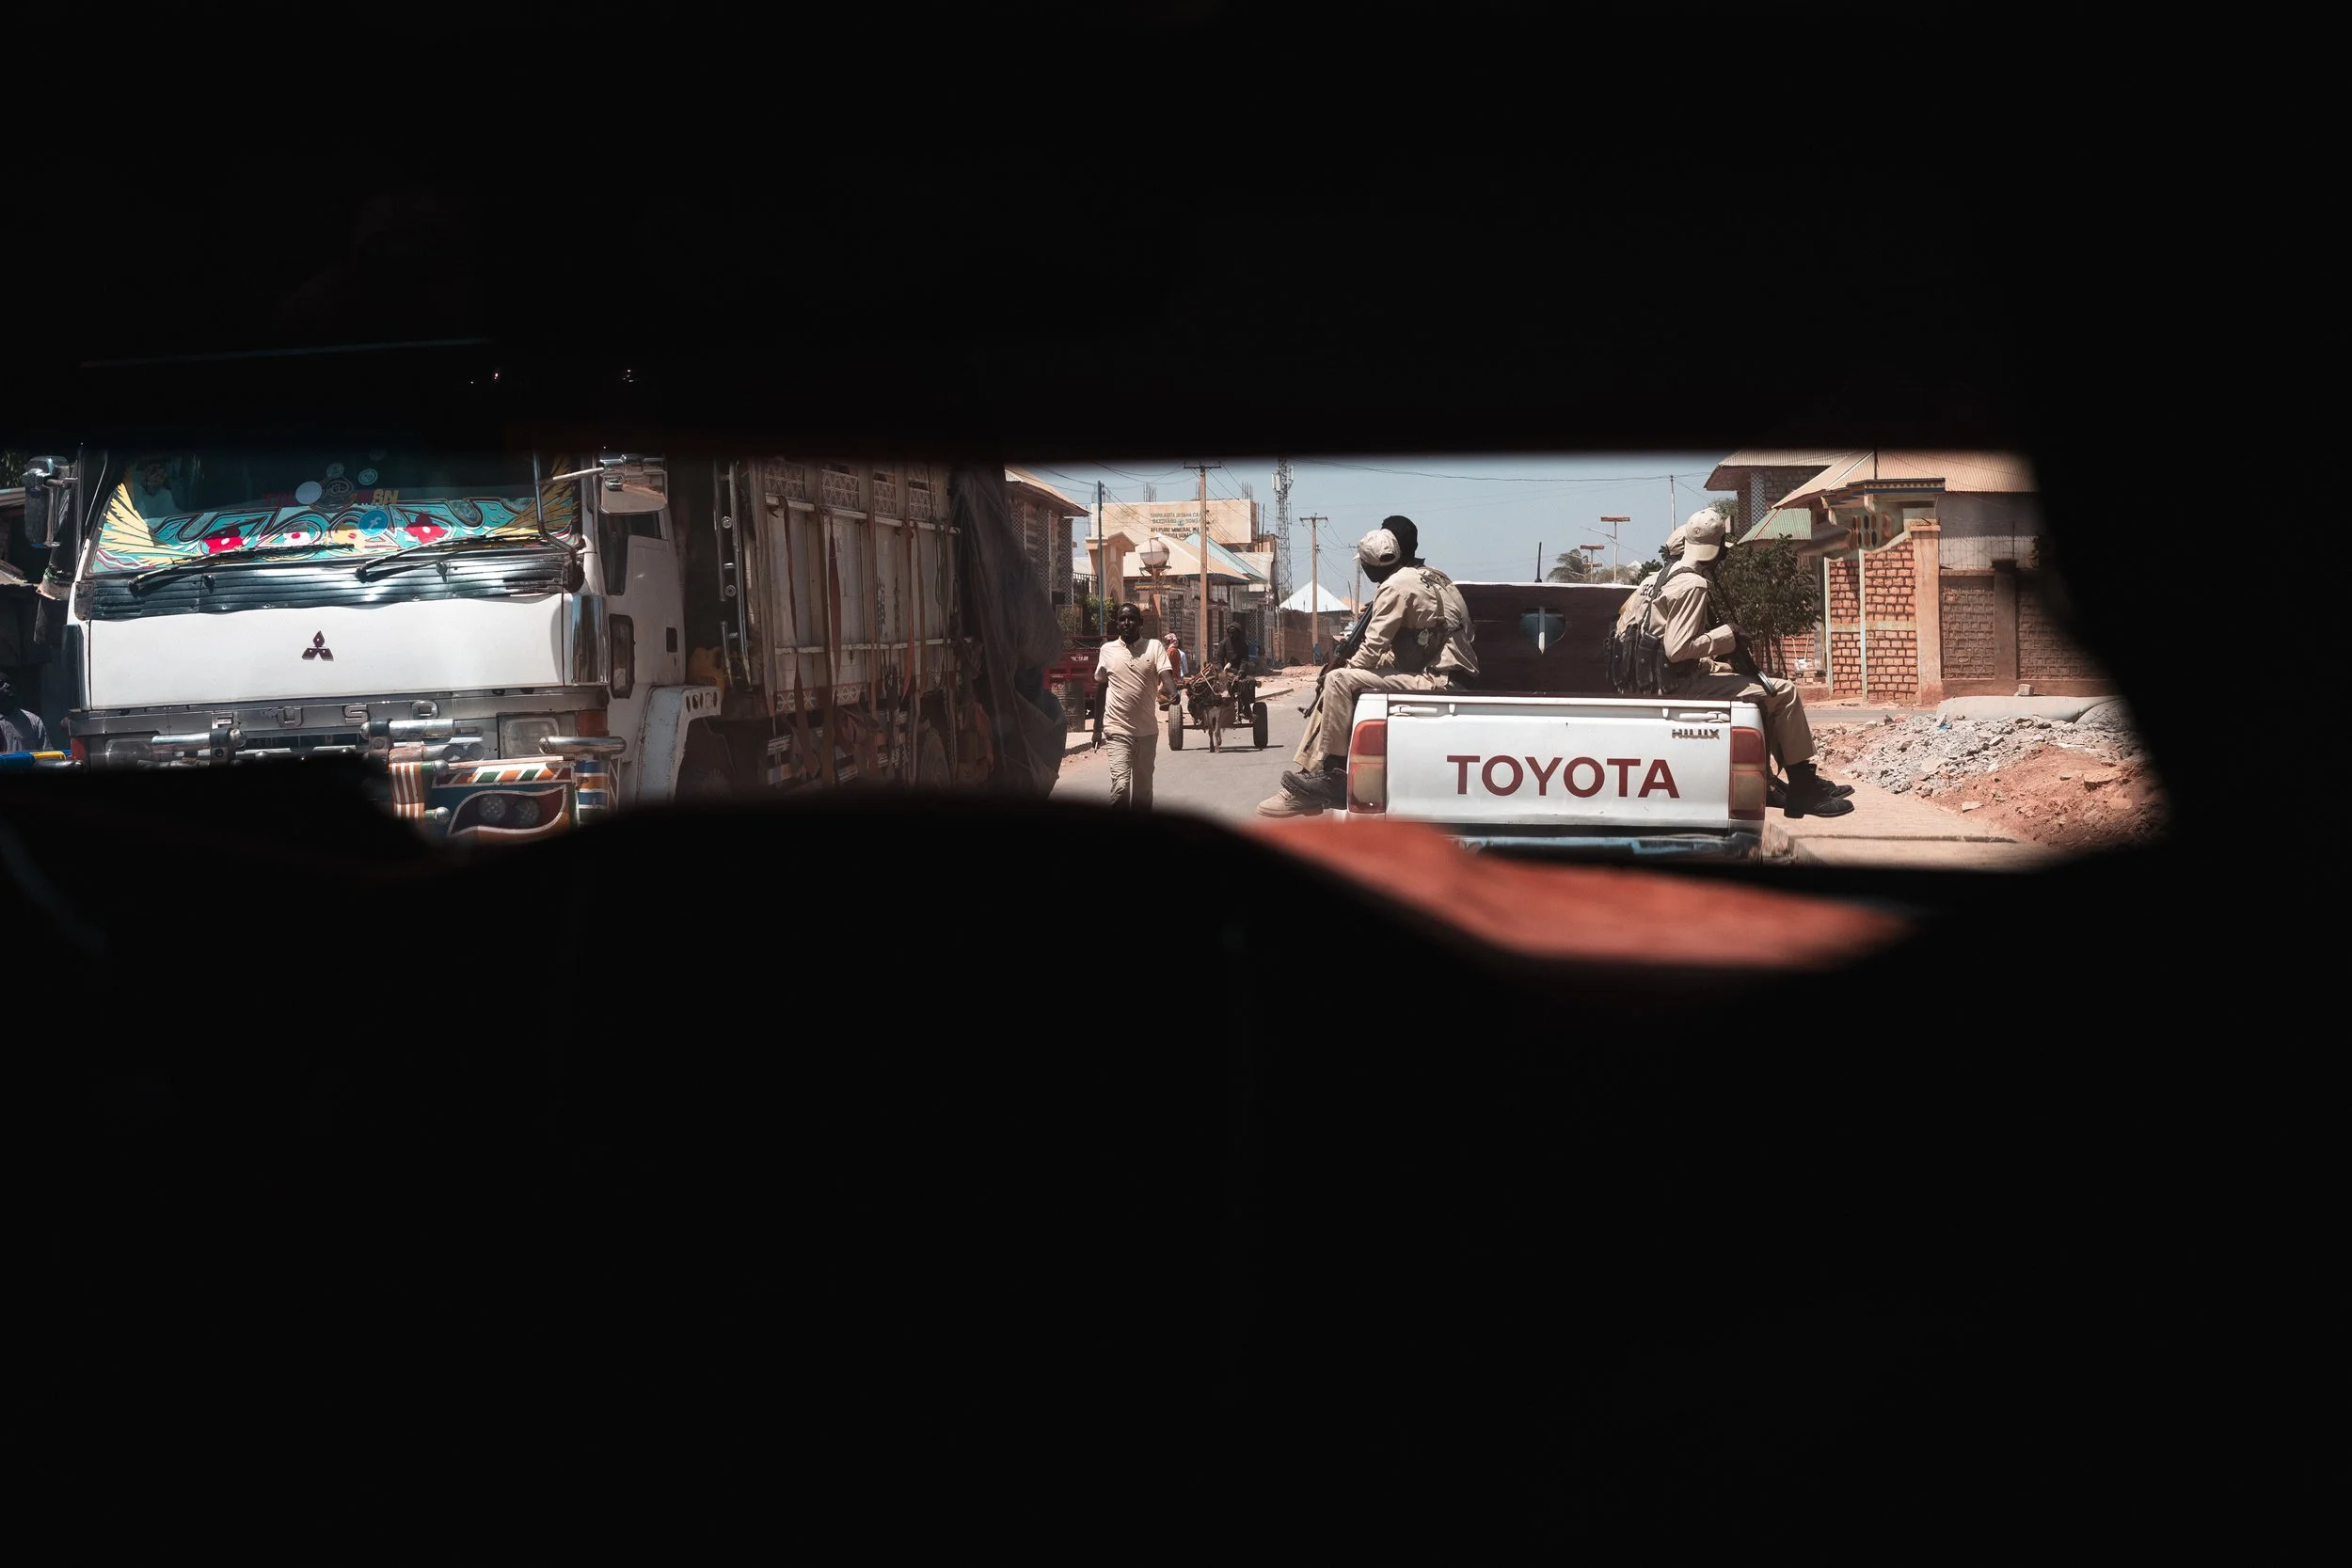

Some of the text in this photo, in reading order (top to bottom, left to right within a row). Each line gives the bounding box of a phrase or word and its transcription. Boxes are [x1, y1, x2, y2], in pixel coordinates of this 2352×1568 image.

[211, 700, 438, 730] FUSO
[1672, 728, 1720, 739] HILUX
[1446, 754, 1680, 799] TOYOTA
